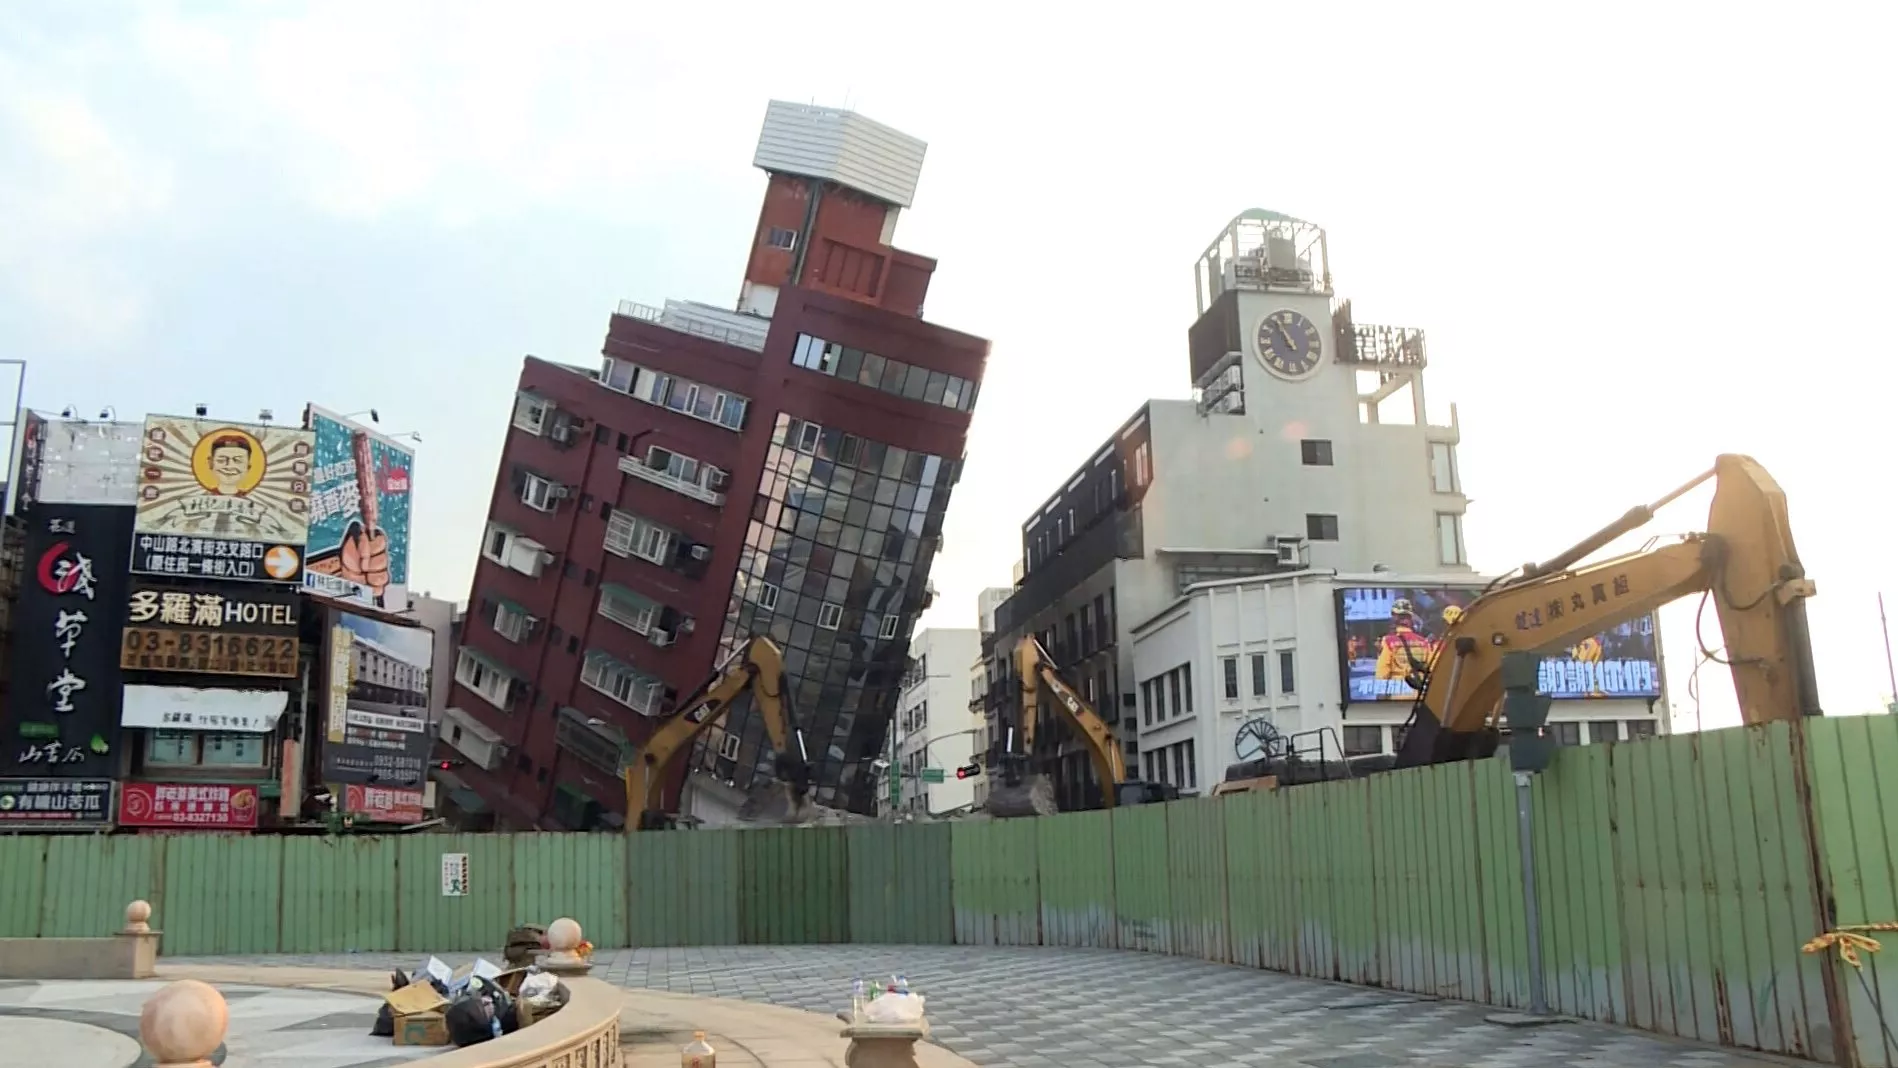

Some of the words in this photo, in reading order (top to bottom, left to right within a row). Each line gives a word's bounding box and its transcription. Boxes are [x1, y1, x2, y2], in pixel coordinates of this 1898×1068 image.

[140, 535, 263, 558] 中山路北濱街交叉路口
[129, 590, 224, 627] 多羅滿
[225, 601, 297, 625] HOTEL
[127, 630, 294, 658] 03-8316622
[1538, 660, 1653, 693] 謝謝你們
